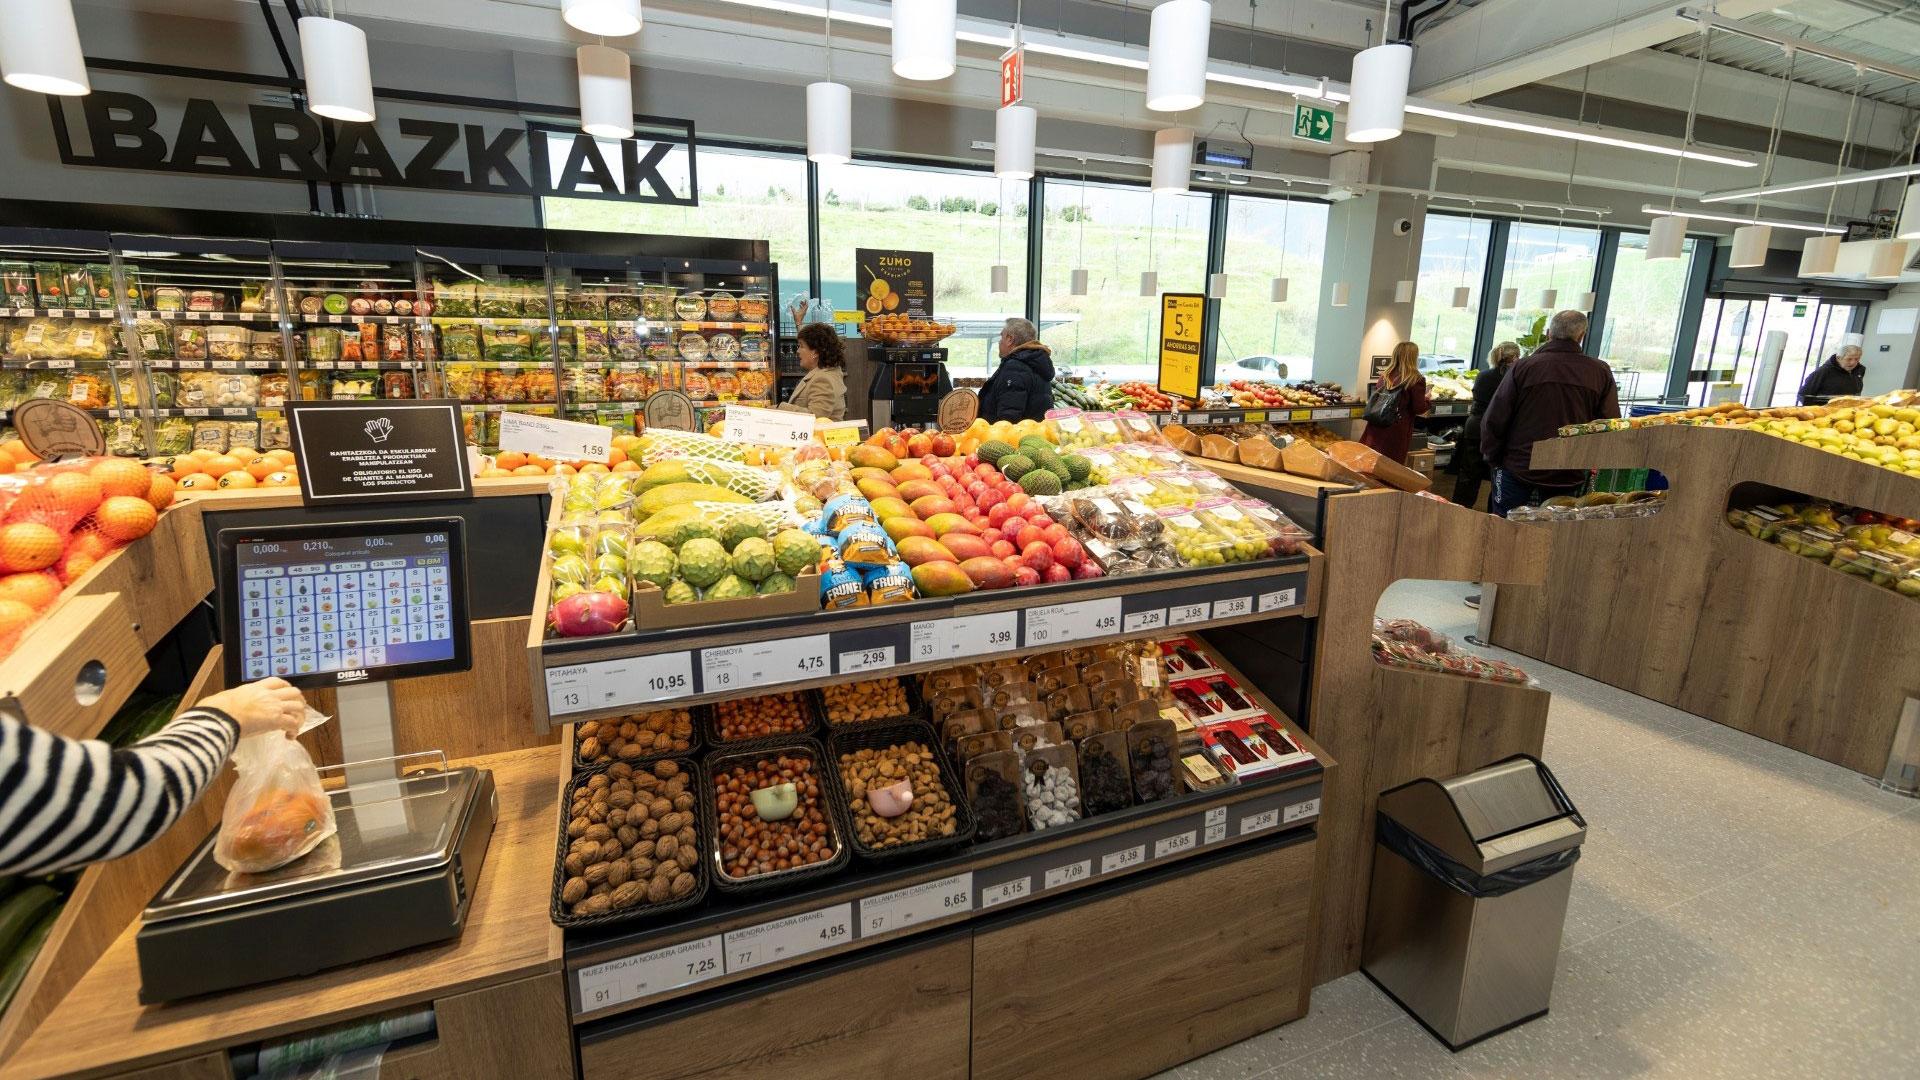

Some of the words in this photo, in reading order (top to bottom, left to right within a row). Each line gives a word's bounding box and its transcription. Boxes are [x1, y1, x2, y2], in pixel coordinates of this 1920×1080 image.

[83, 89, 676, 202] BARAZKIAK
[880, 256, 912, 266] ZUMO
[1175, 314, 1183, 336] 5
[1167, 342, 1187, 350] AHORRAS
[733, 428, 743, 438] 79
[790, 432, 808, 441] 5,49
[582, 444, 603, 456] 1,59
[253, 544, 279, 554] 0,000
[303, 541, 329, 551] 0,210
[366, 538, 384, 547] 0,00
[425, 535, 444, 544] 0,00
[873, 576, 910, 589] FRUNET
[1028, 609, 1050, 617] CIRUELA
[914, 622, 935, 630] MANGO
[1033, 630, 1048, 640] 100
[704, 648, 743, 658] CHIRIMOYA
[921, 644, 933, 655] 33
[337, 670, 369, 679] DIBAL
[549, 667, 588, 678] PITAHAYA
[717, 672, 730, 684] 18
[564, 693, 579, 705] 13
[1002, 883, 1022, 896] 8,15
[863, 894, 893, 907] AVELLANA
[910, 884, 937, 896] CASCARA
[728, 926, 765, 940] ALMENDRA
[766, 920, 798, 931] CASCARA
[798, 911, 824, 923] GRANEL
[872, 918, 884, 929] 57
[582, 969, 603, 977] NUEZ
[604, 962, 627, 972] FINCA
[628, 958, 638, 966] LA
[640, 950, 676, 964] NOGUERA
[678, 943, 706, 953] GRANEL
[739, 952, 752, 963] 77
[596, 989, 609, 1001] 91
